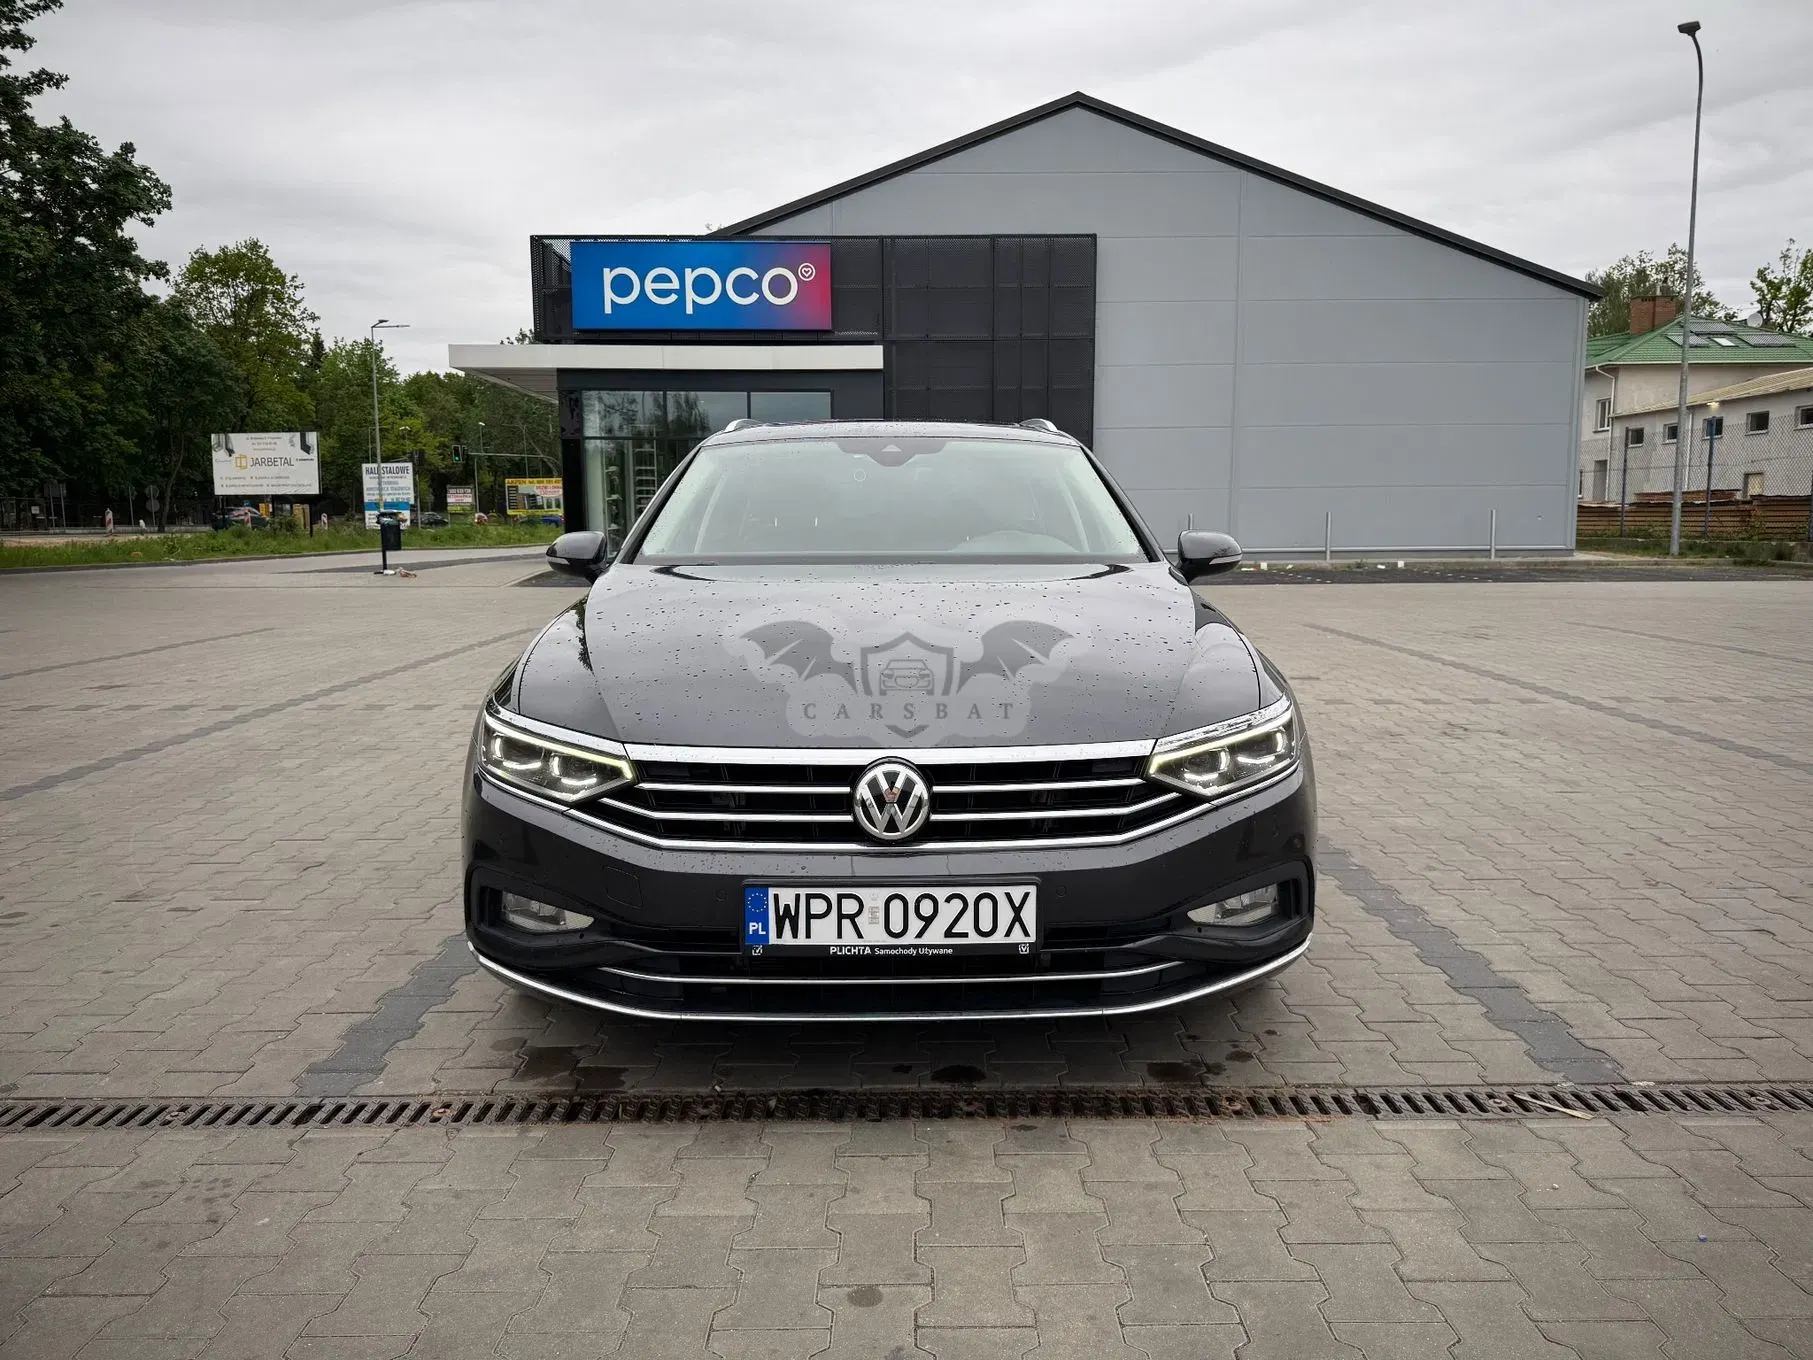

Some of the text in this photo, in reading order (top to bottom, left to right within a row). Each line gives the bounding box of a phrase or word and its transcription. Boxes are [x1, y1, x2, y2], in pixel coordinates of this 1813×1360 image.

[603, 267, 798, 314] pepco
[250, 457, 294, 467] JARBETAL
[365, 466, 410, 475] HAL STALOWE
[773, 891, 1031, 939] WPR 0920X
[749, 922, 766, 935] PL
[829, 946, 953, 956] PLICHTA Samochody Używane
